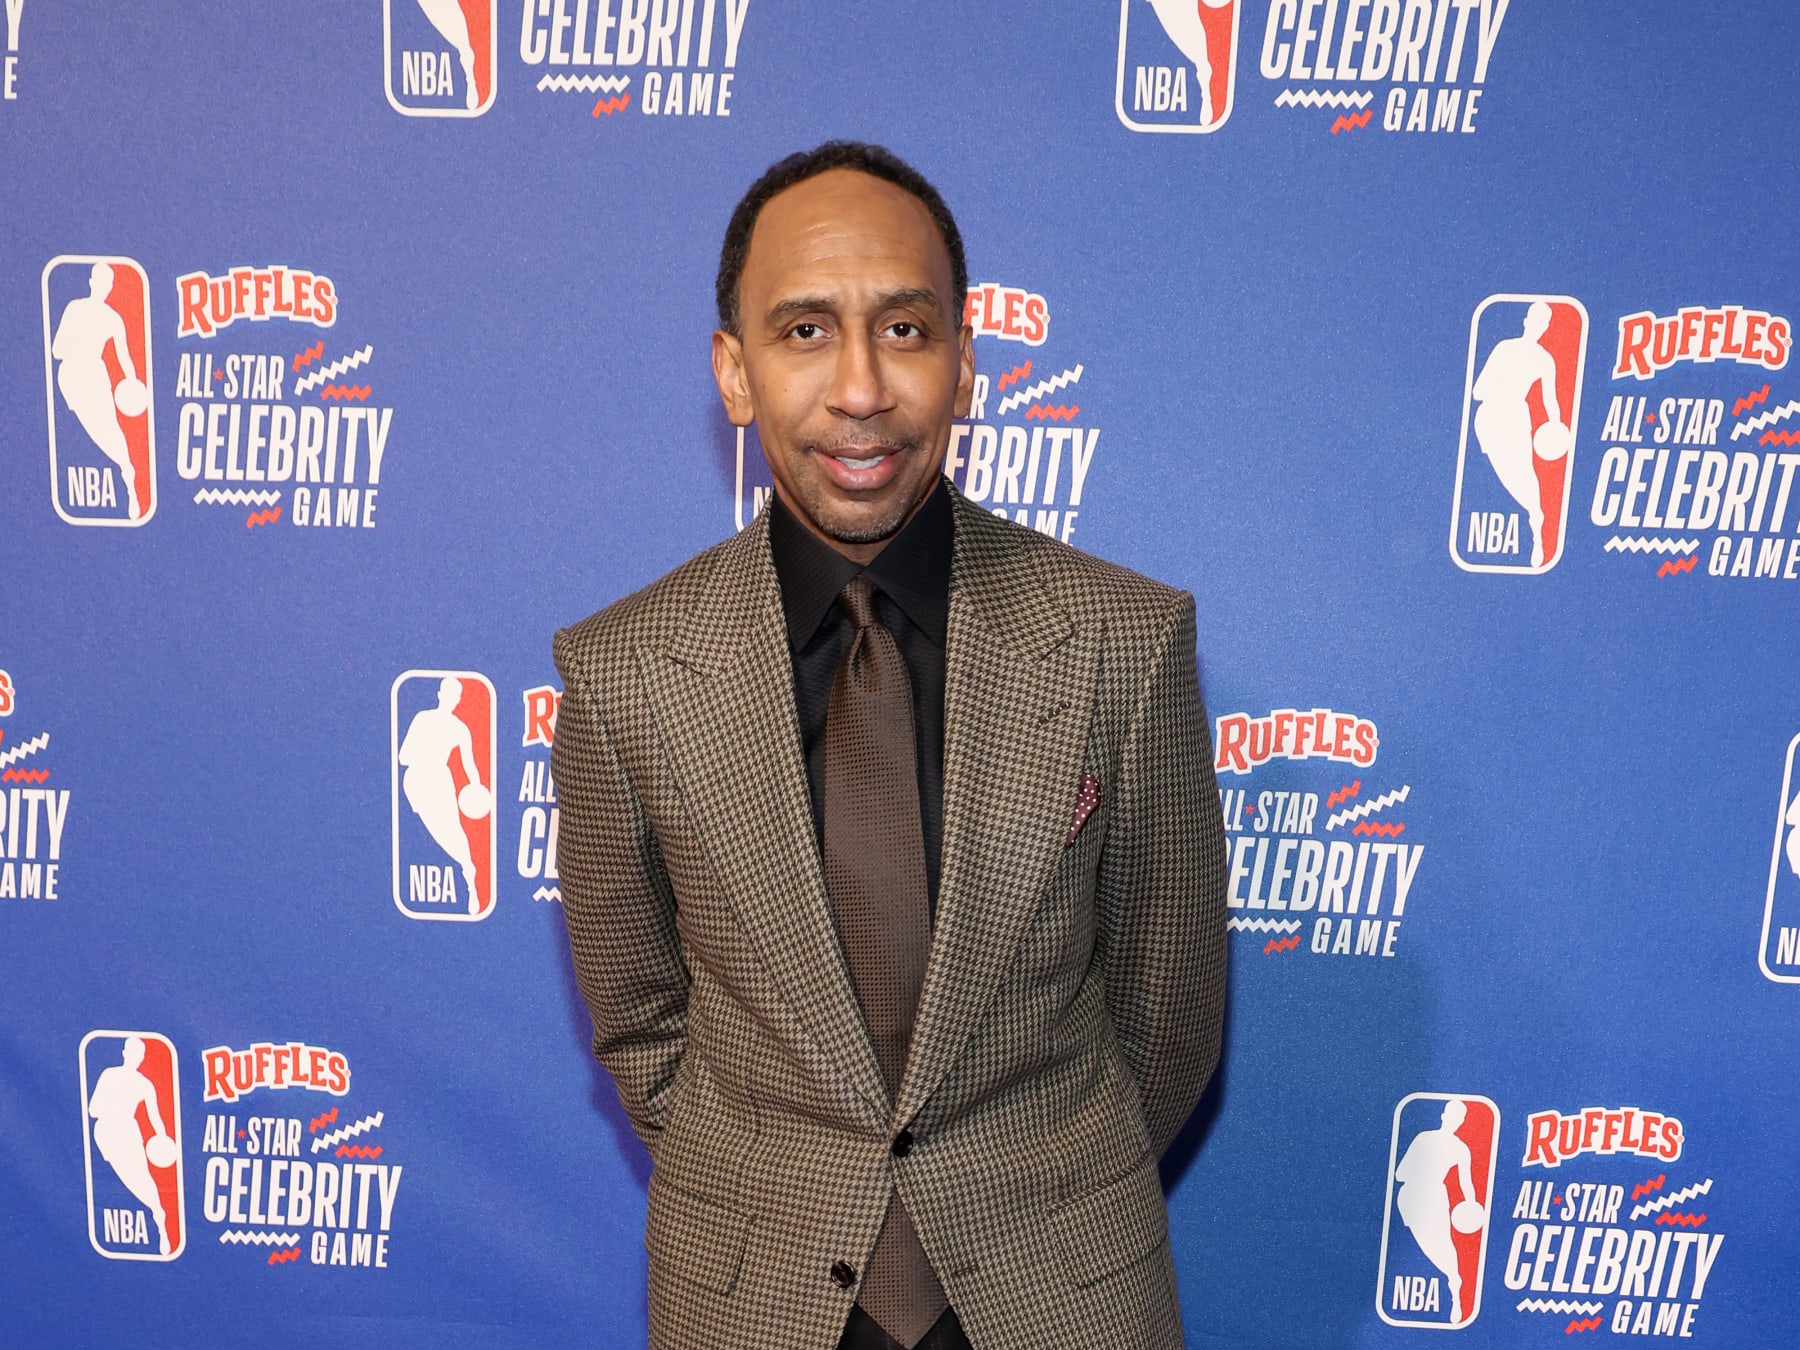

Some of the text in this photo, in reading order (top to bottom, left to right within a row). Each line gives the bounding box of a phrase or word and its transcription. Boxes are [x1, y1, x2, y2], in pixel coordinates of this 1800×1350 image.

[1259, 0, 1510, 84] CELEBRITY
[402, 50, 454, 97] NBA
[641, 71, 735, 117] GAME
[1133, 65, 1188, 113] NBA
[1383, 87, 1483, 134] GAME
[178, 267, 336, 337] RUFFLES
[963, 287, 1046, 342] FLES
[1614, 307, 1788, 379] RUFFLES
[176, 401, 394, 485] CELEBRITY
[944, 425, 1100, 506] EBRITY
[67, 465, 117, 508] NBA
[292, 486, 379, 529] GAME
[1590, 446, 1800, 534] CELEBRIT
[1466, 511, 1520, 555] NBA
[1216, 710, 1376, 773] RUFFLES
[1218, 788, 1246, 832] LL
[0, 862, 59, 900] AME
[409, 864, 457, 904] NBA
[1225, 836, 1425, 917] ELEBRITY
[1311, 917, 1402, 957] GAME
[203, 1045, 347, 1100] RUFFLES
[1524, 1109, 1681, 1166] RUFFLES
[203, 1156, 403, 1231] CELEBRITY
[103, 1208, 150, 1245] NBA
[310, 1230, 390, 1268] GAME
[1503, 1223, 1725, 1300] CELEBRITY
[1392, 1275, 1440, 1313] NBA
[1611, 1299, 1700, 1338] GAME
